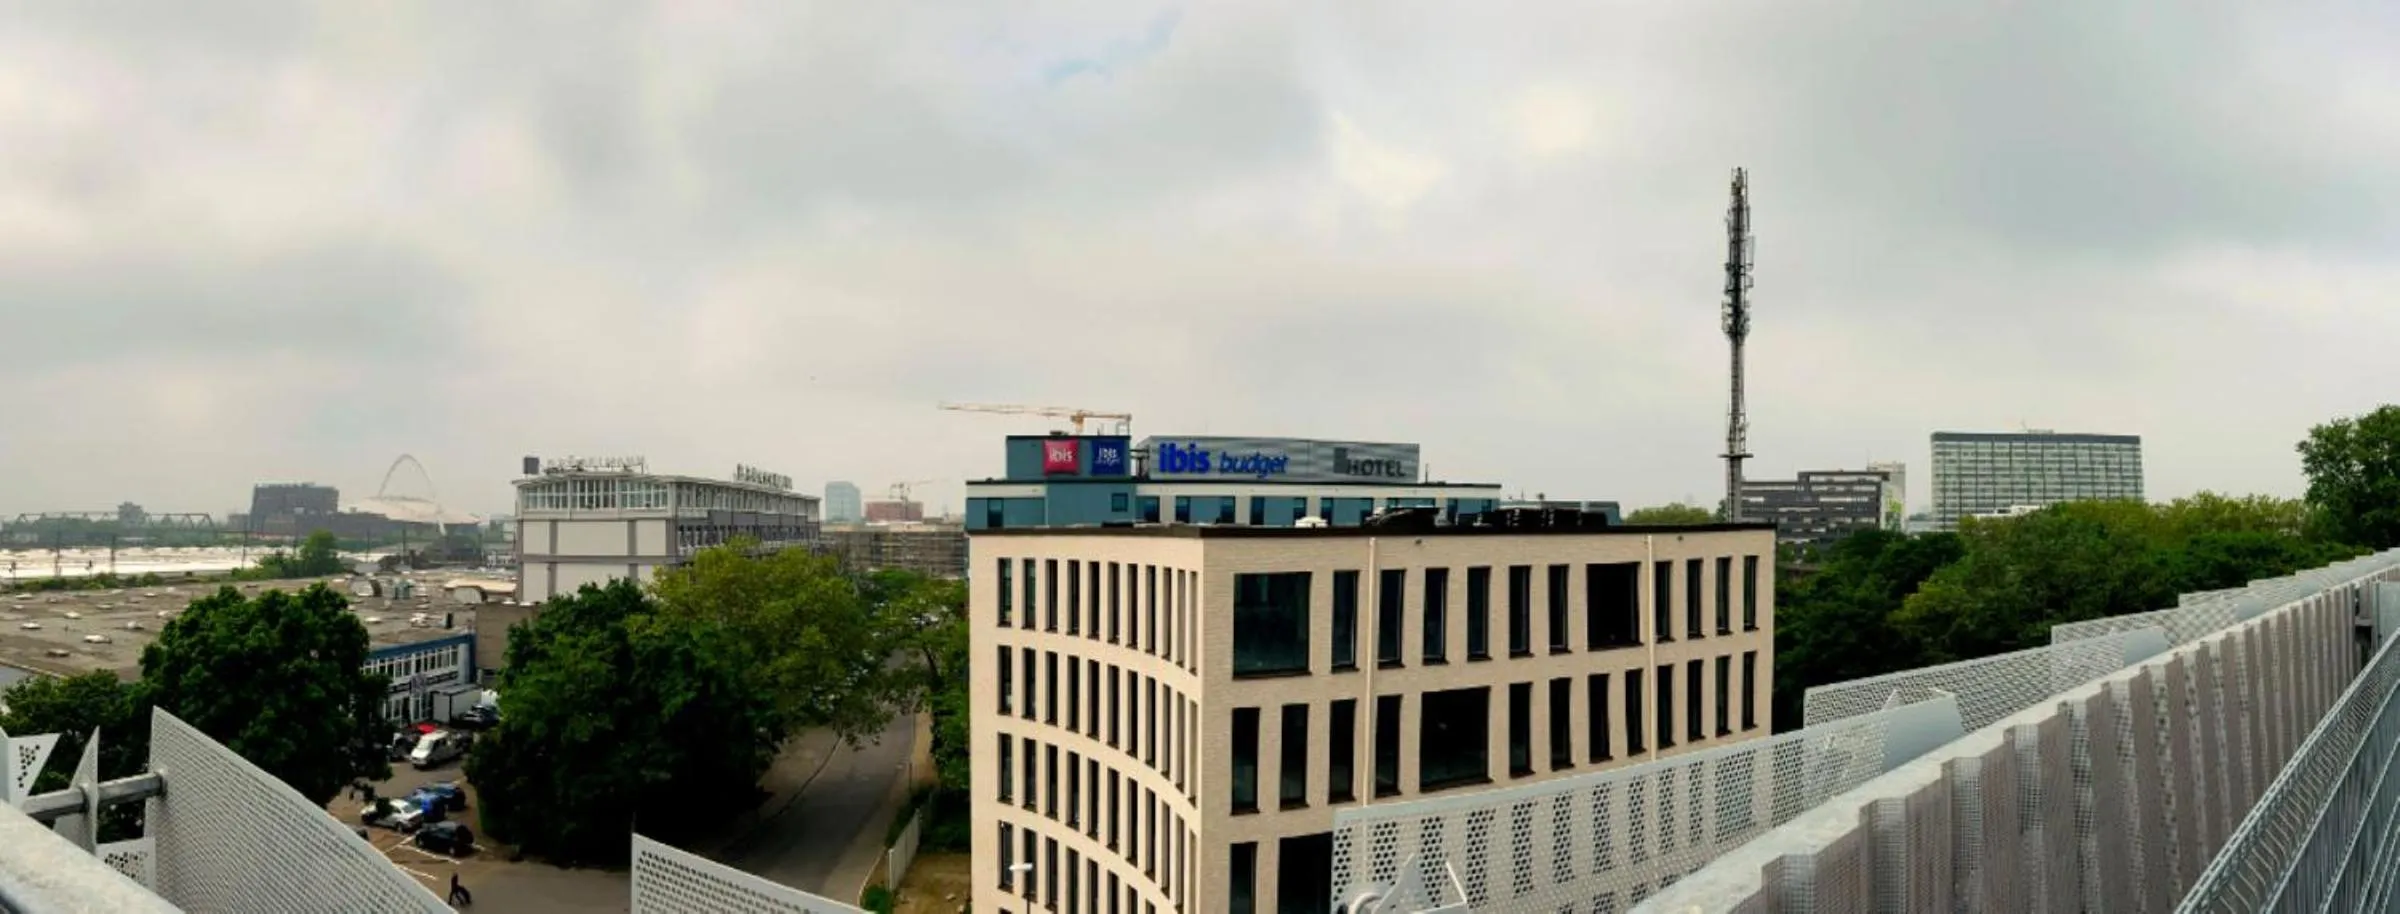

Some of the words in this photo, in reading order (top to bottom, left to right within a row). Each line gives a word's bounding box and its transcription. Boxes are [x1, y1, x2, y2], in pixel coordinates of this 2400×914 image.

[1049, 447, 1073, 462] ibis
[1159, 443, 1211, 473] ibis
[1219, 451, 1289, 478] budget
[1347, 458, 1407, 477] HOTEL
